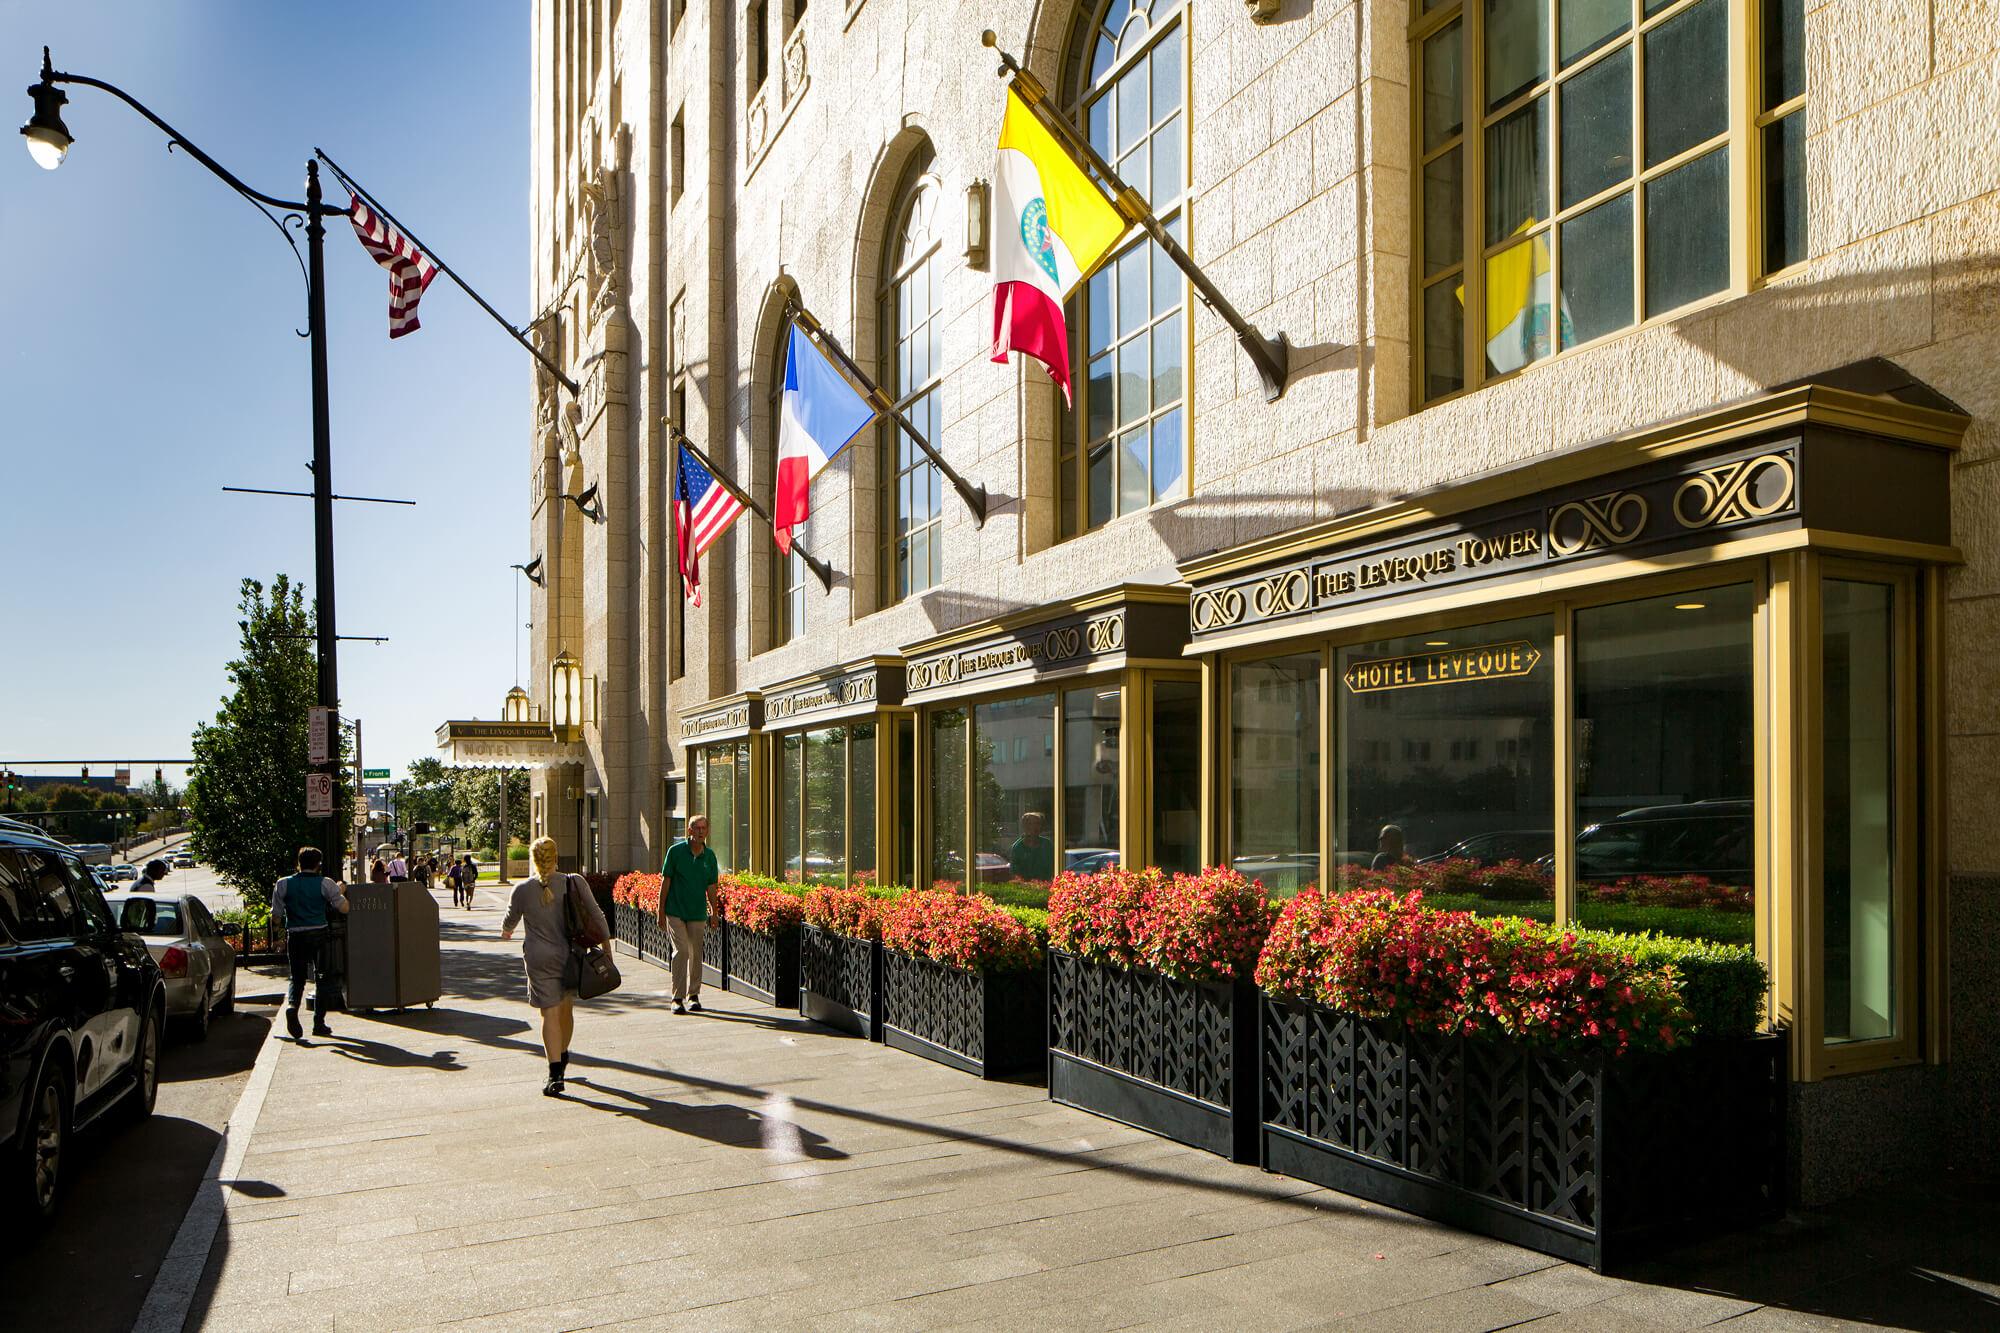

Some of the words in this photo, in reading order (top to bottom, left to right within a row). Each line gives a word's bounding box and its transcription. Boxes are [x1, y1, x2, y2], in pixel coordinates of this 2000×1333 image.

[1313, 571, 1351, 597] THE
[1456, 528, 1542, 566] TOWER
[1357, 662, 1416, 689] HOTEL
[1427, 646, 1522, 681] LEVEQUE
[473, 727, 488, 736] THE
[523, 728, 547, 736] TOWER
[464, 743, 513, 757] HOTEL
[356, 804, 366, 812] 40
